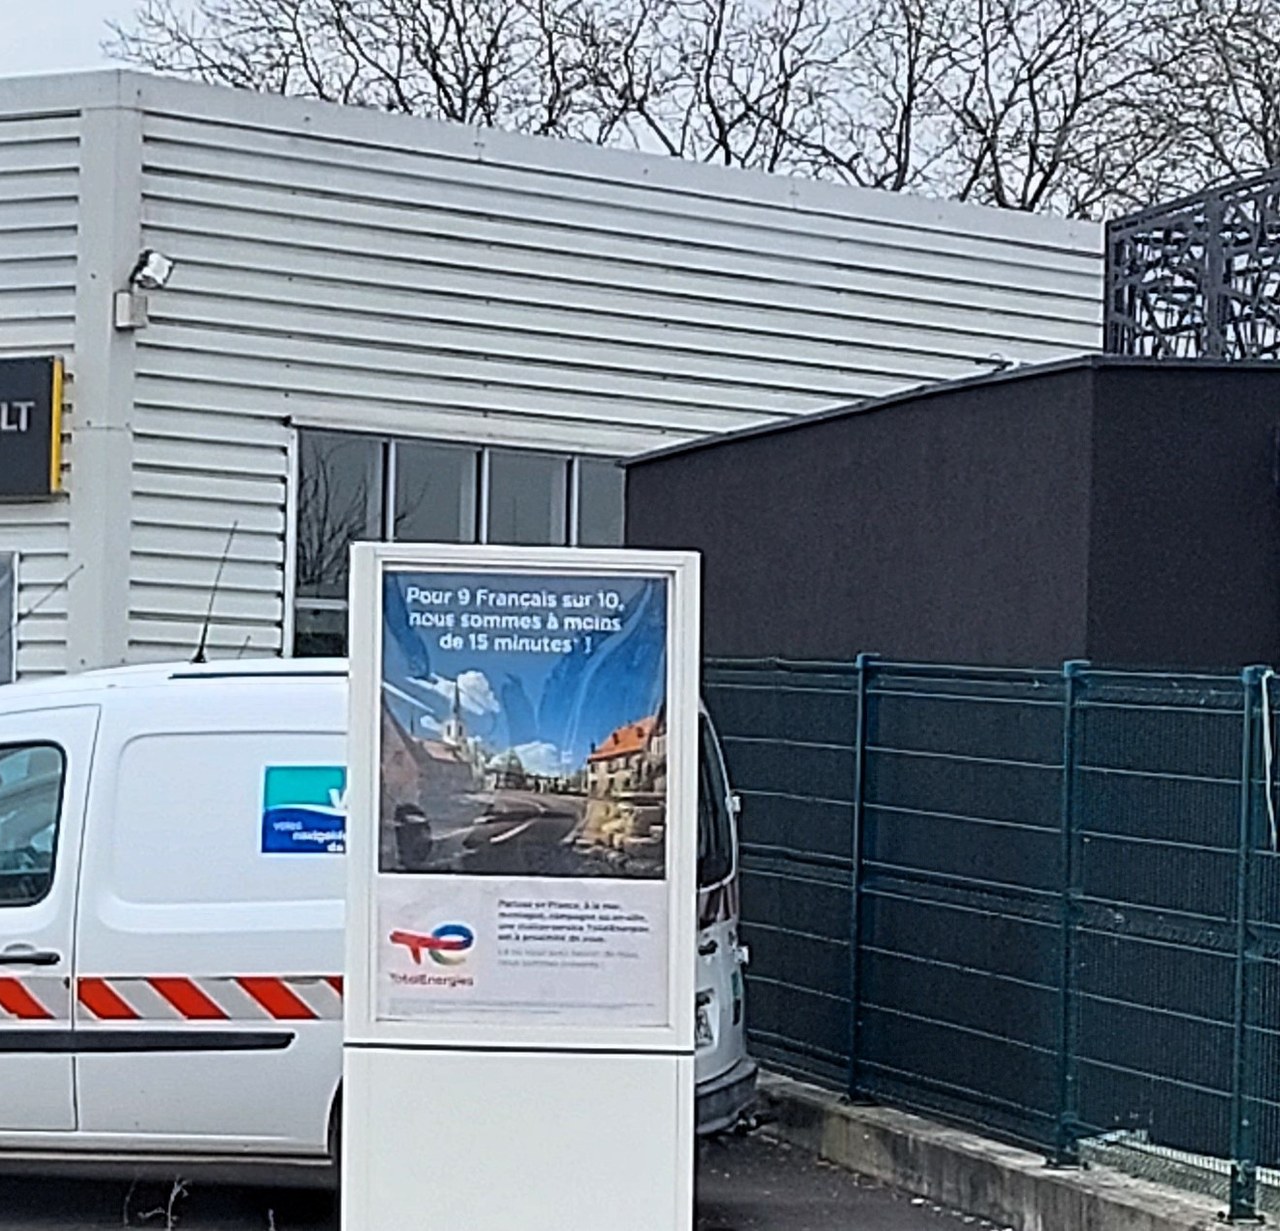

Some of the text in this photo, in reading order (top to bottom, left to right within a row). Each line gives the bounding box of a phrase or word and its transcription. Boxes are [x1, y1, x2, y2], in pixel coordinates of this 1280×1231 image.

[406, 587, 452, 604] Pour
[457, 588, 470, 606] 9
[562, 594, 593, 608] sur
[597, 589, 625, 612] 10,
[409, 611, 622, 631] nous sommes à moins
[439, 632, 463, 650] de
[469, 633, 488, 651] 15
